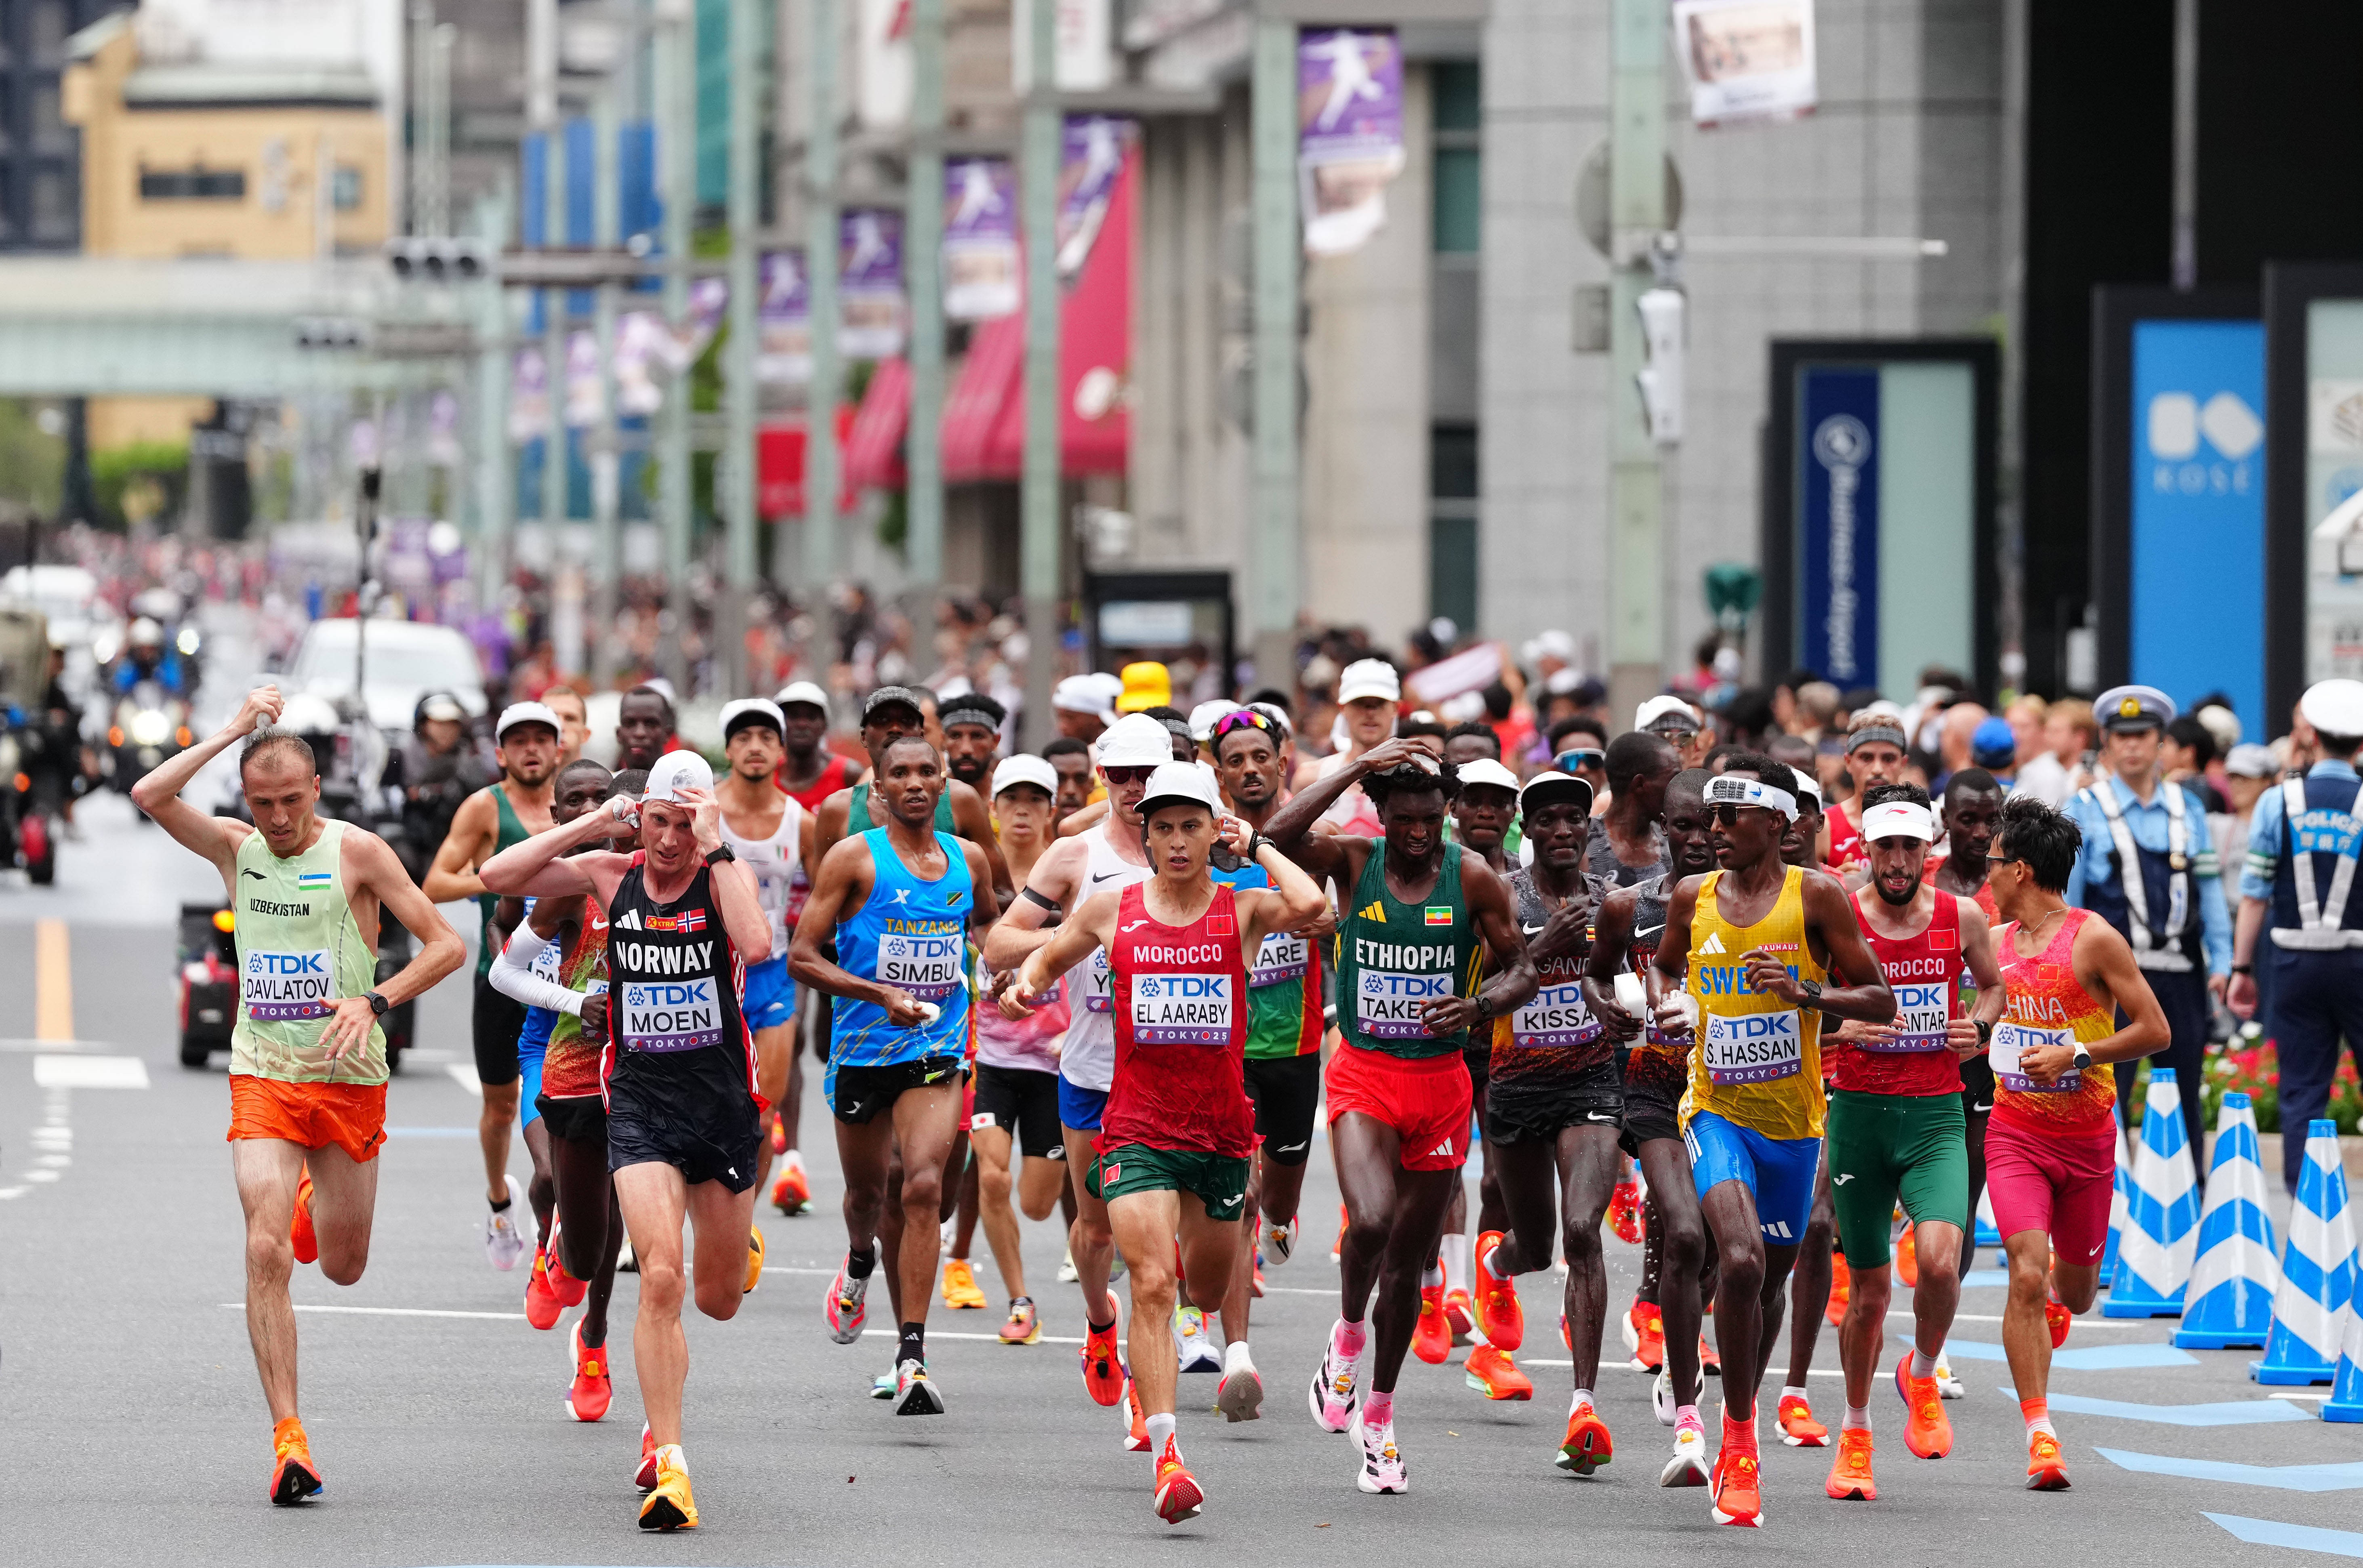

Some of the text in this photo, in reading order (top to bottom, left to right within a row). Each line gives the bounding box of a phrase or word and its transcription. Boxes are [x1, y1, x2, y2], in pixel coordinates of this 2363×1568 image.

[2292, 811, 2361, 836] POLICE
[250, 898, 309, 916] UZBEKISTAN
[616, 941, 713, 974] NORWAY
[907, 937, 957, 957] TDK
[1134, 944, 1222, 965] MOROCCO
[1254, 943, 1302, 967] ARE
[1356, 937, 1455, 969] ETHIOPIA
[263, 953, 324, 974] TDK
[885, 962, 955, 982] SIMBU
[1881, 958, 1945, 978] OROCCO
[247, 977, 329, 999] DAVLATOV
[1160, 978, 1225, 998] TDK
[1384, 976, 1446, 996] TDK
[1700, 965, 1799, 994] SWEN
[644, 982, 710, 1005] TDK
[1539, 984, 1584, 1006] TD
[1137, 1004, 1228, 1024] EL AARABY
[1363, 997, 1428, 1019] TAKE
[1524, 1006, 1593, 1030] KISSA
[632, 1008, 711, 1032] MOEN
[1724, 1015, 1791, 1039] TDK
[1894, 1011, 1945, 1032] ANTAR
[1707, 1038, 1796, 1064] S. HASSAN
